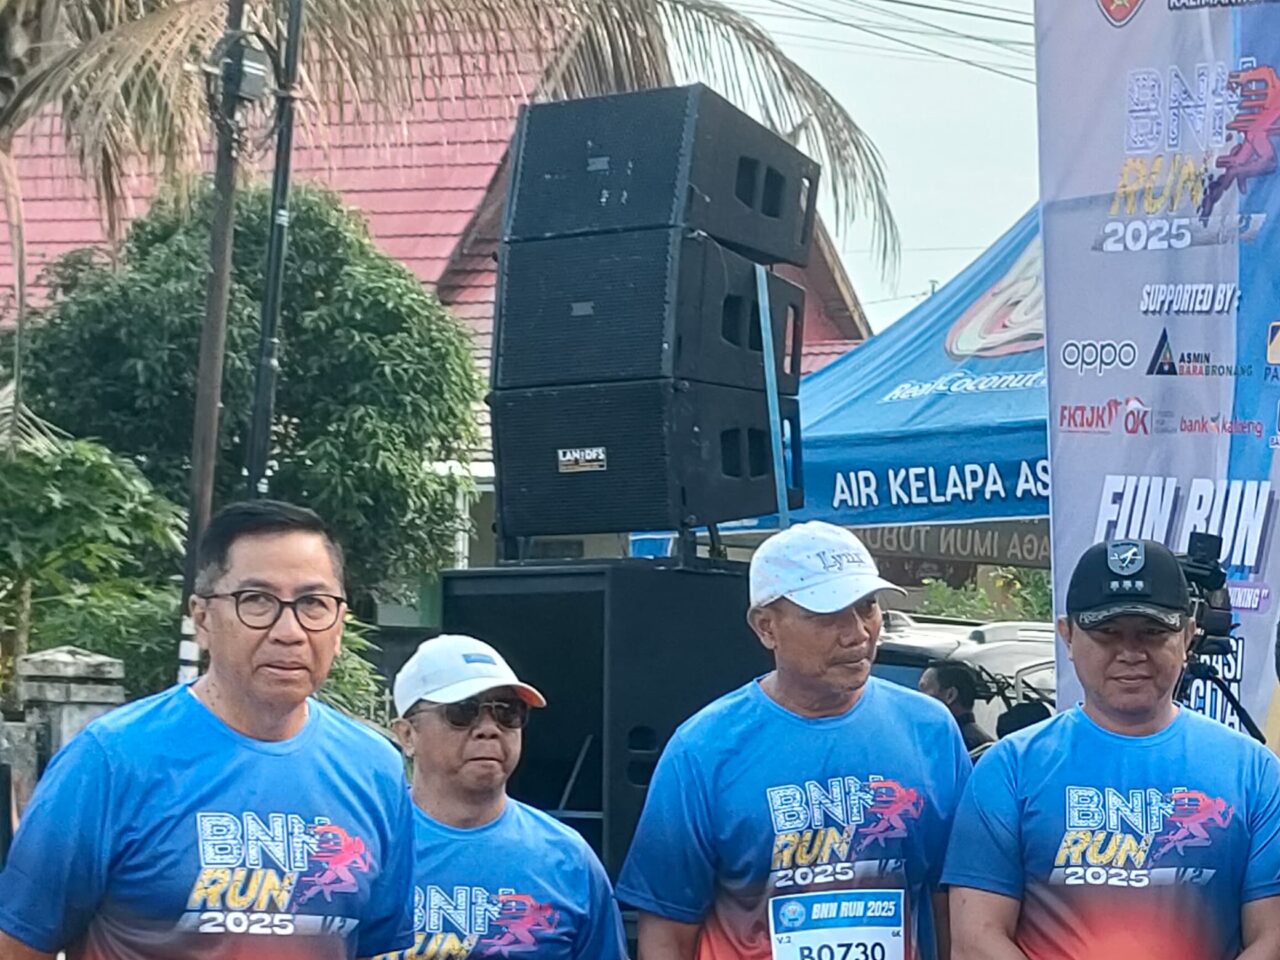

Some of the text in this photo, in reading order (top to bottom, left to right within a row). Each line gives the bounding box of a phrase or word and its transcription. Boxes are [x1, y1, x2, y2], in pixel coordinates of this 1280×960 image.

[1109, 153, 1203, 217] RUN
[1102, 218, 1192, 251] 2025
[1140, 283, 1214, 314] SUPPORTED
[1061, 340, 1137, 375] oppo
[1179, 352, 1211, 364] ASMIN
[1180, 416, 1209, 433] bank
[832, 470, 880, 509] AIR
[888, 462, 1006, 505] KELAPA
[771, 824, 856, 870] RUN
[1054, 830, 1155, 868] RUN
[186, 867, 299, 913] RUN
[774, 863, 855, 888] 2025
[1064, 867, 1150, 887] 2025
[199, 911, 295, 935] 2025
[839, 901, 865, 918] RUN
[866, 901, 897, 917] 2025
